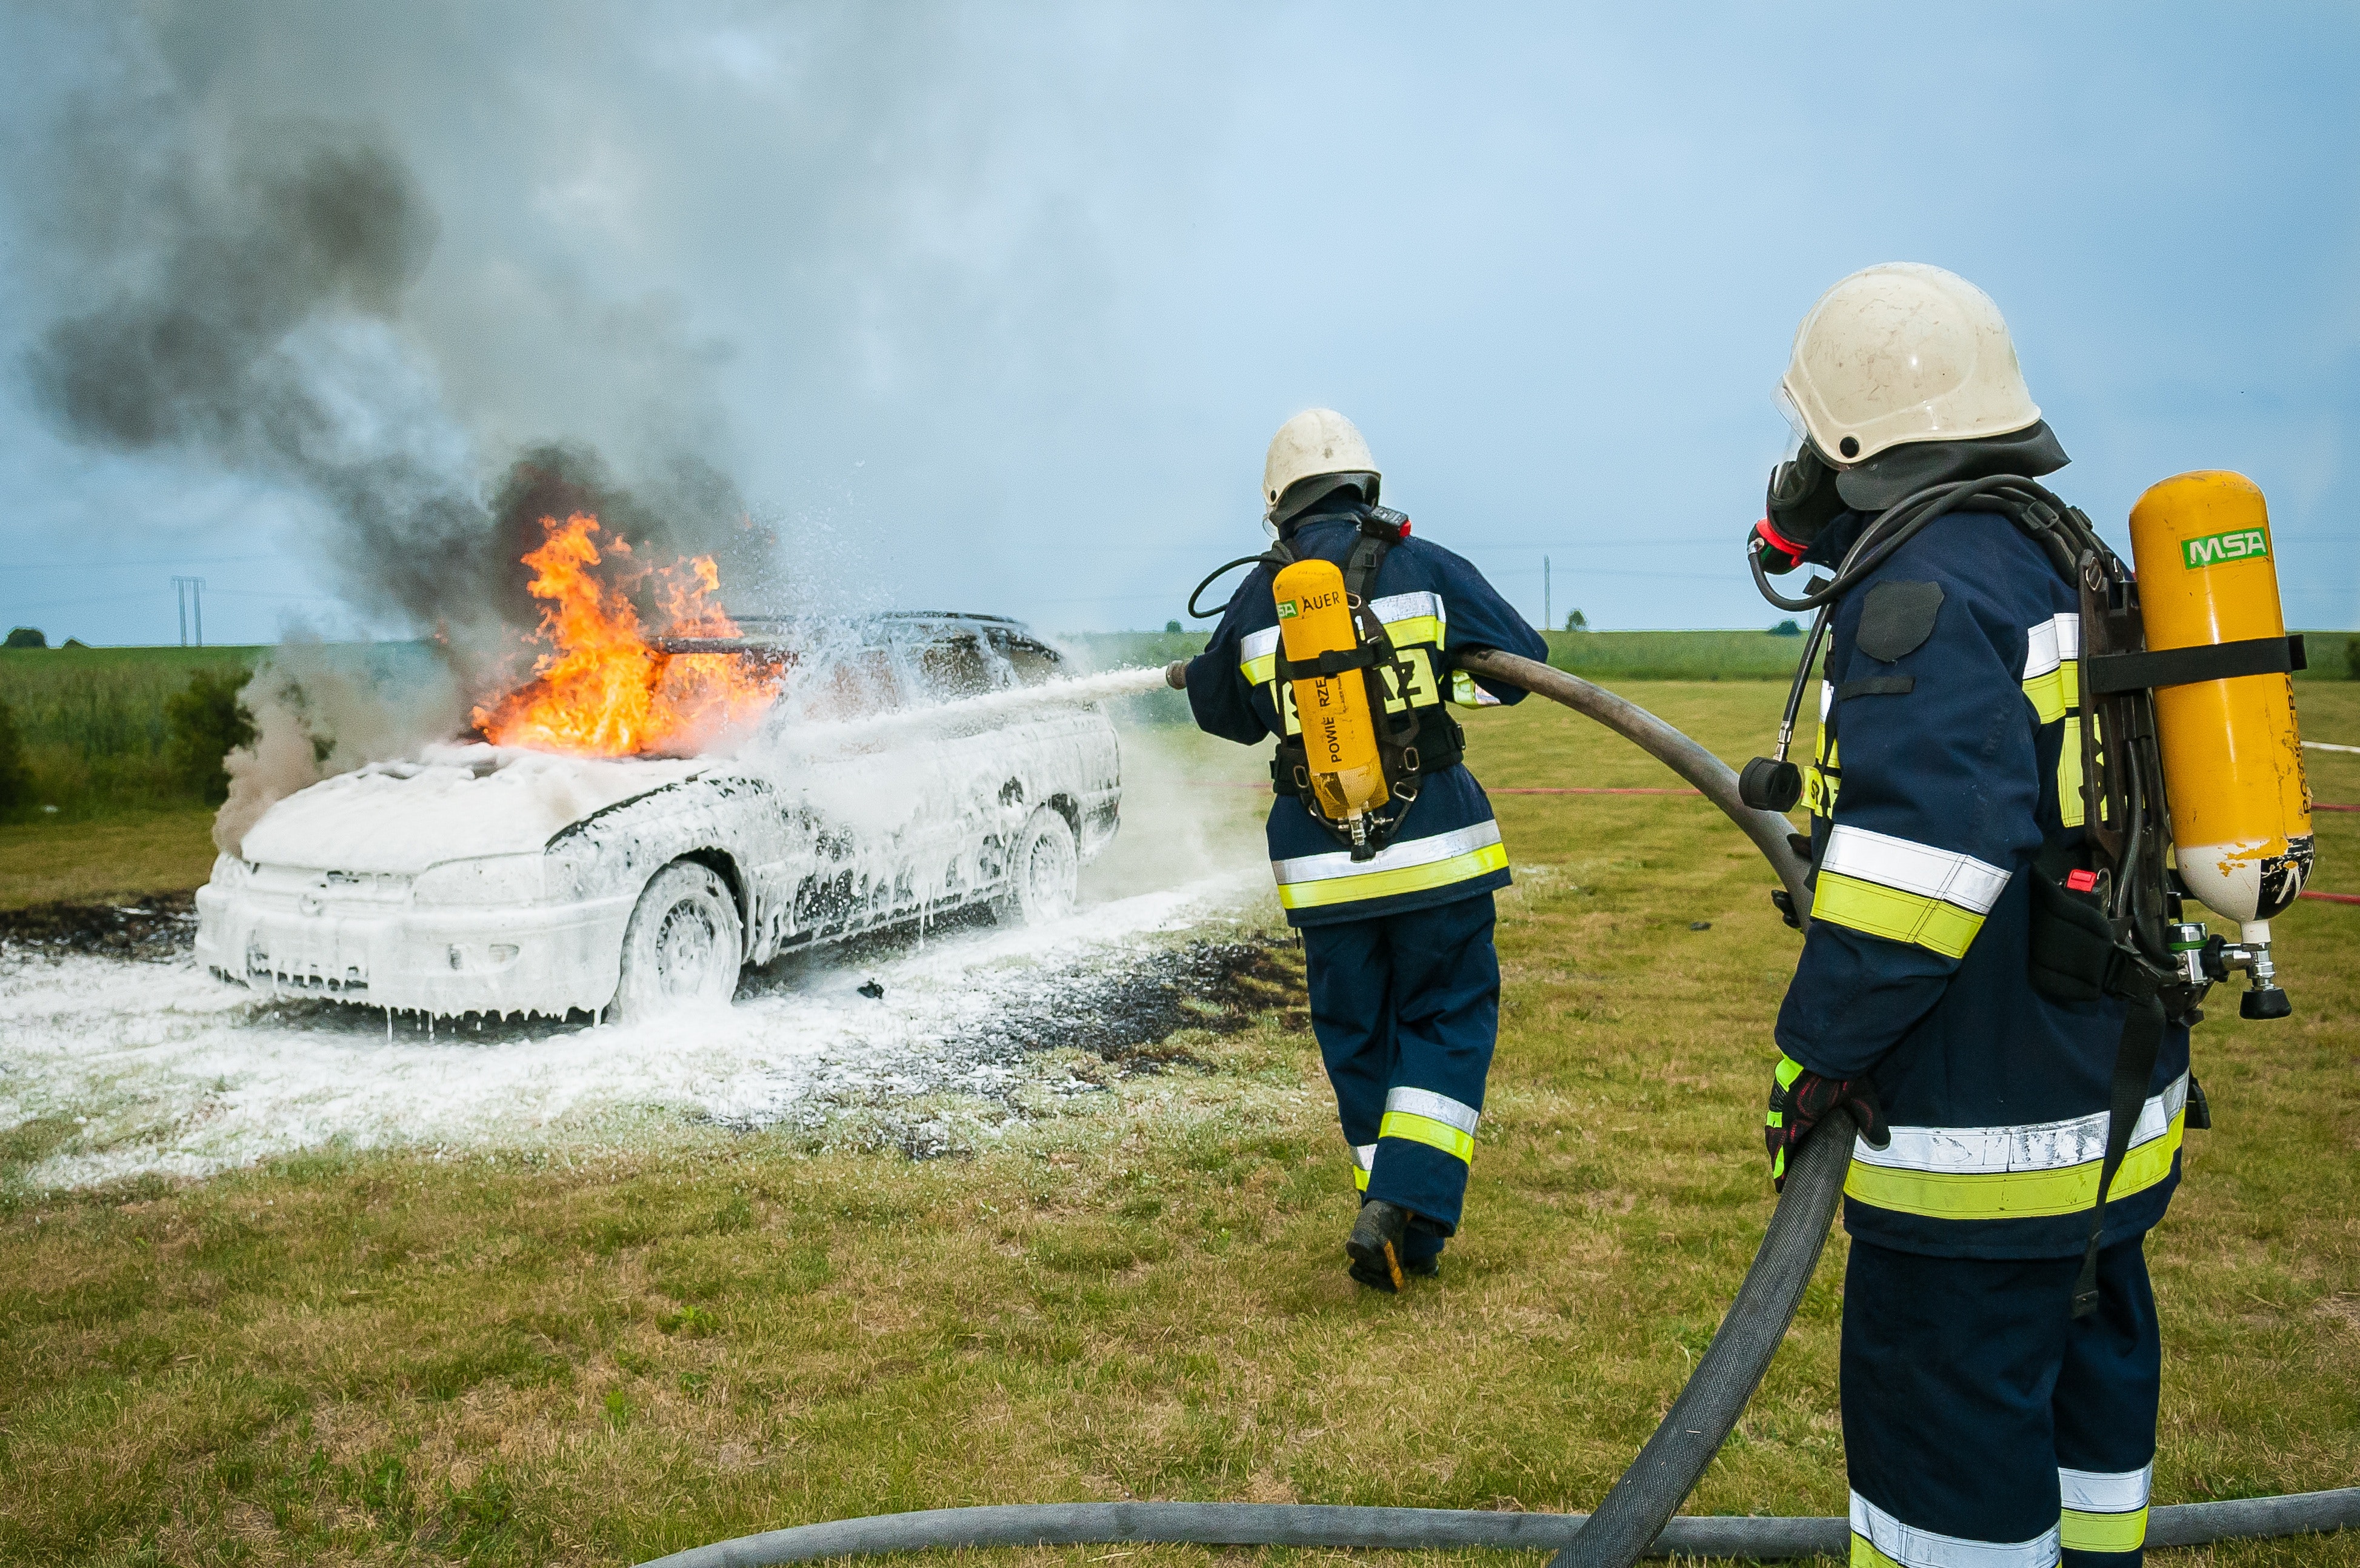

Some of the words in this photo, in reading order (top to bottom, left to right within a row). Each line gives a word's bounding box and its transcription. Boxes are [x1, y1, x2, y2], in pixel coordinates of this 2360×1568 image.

[2189, 531, 2267, 565] MSA
[1276, 603, 1296, 618] SA
[1302, 591, 1341, 613] AUER
